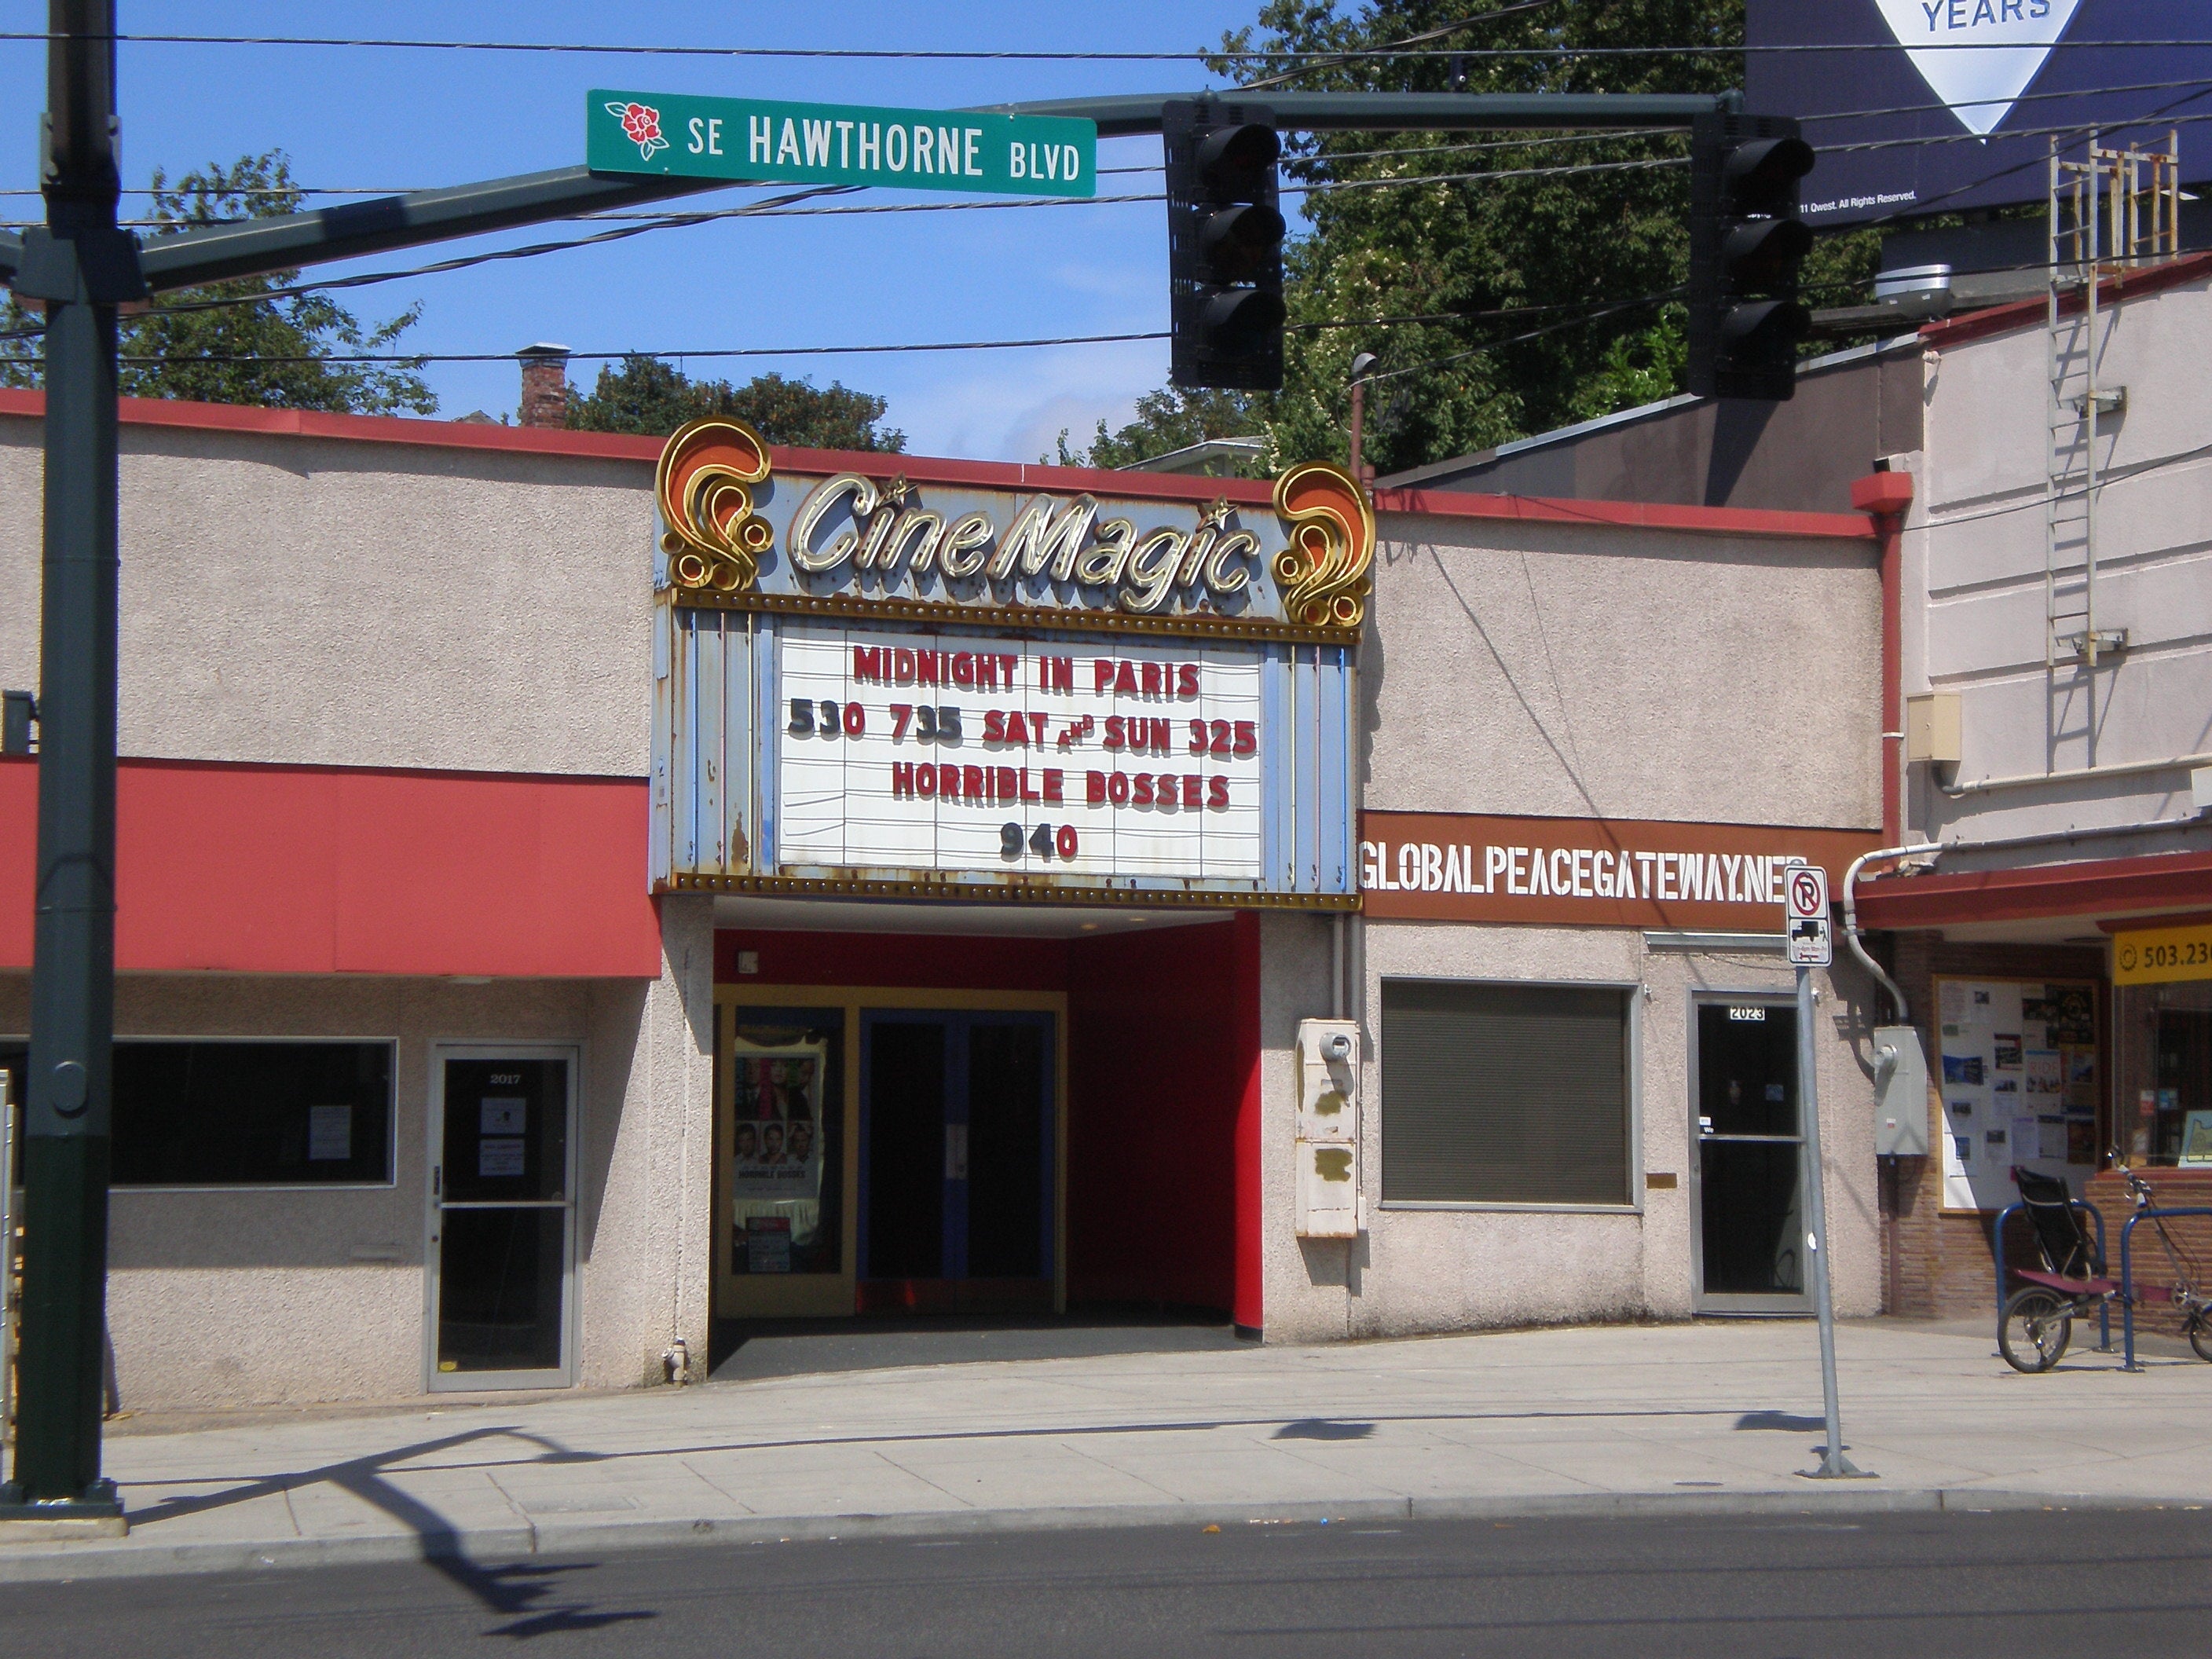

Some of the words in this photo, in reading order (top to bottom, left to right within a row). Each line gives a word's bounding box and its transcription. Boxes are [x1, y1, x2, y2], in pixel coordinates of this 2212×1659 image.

[689, 117, 723, 155] SE
[750, 115, 983, 176] HAWTHORNE
[1010, 143, 1079, 181] BLVD
[1811, 200, 1837, 214] Qwest.
[1839, 199, 1849, 210] All
[1851, 195, 1877, 209] Rights
[1877, 190, 1917, 204] Reserved.
[786, 471, 1259, 613] CineMagic
[854, 645, 1019, 691] MIDNIGHT
[1040, 655, 1074, 691] IN
[1096, 658, 1200, 697] PARIS
[789, 698, 866, 738] 530
[890, 703, 962, 741] 735
[984, 710, 1046, 745] SAT
[1057, 714, 1093, 746] AND
[1103, 716, 1170, 751] SUN
[1189, 720, 1258, 754] 325
[893, 762, 1064, 803] HORRIBLE
[1086, 771, 1230, 808] BOSSES
[1000, 822, 1079, 859] 940
[1359, 840, 1807, 903] GLOBALPEACEGATEWAY.NE
[2144, 942, 2212, 969] 503.23
[1730, 1007, 1764, 1020] 2023
[489, 1073, 521, 1085] 2017
